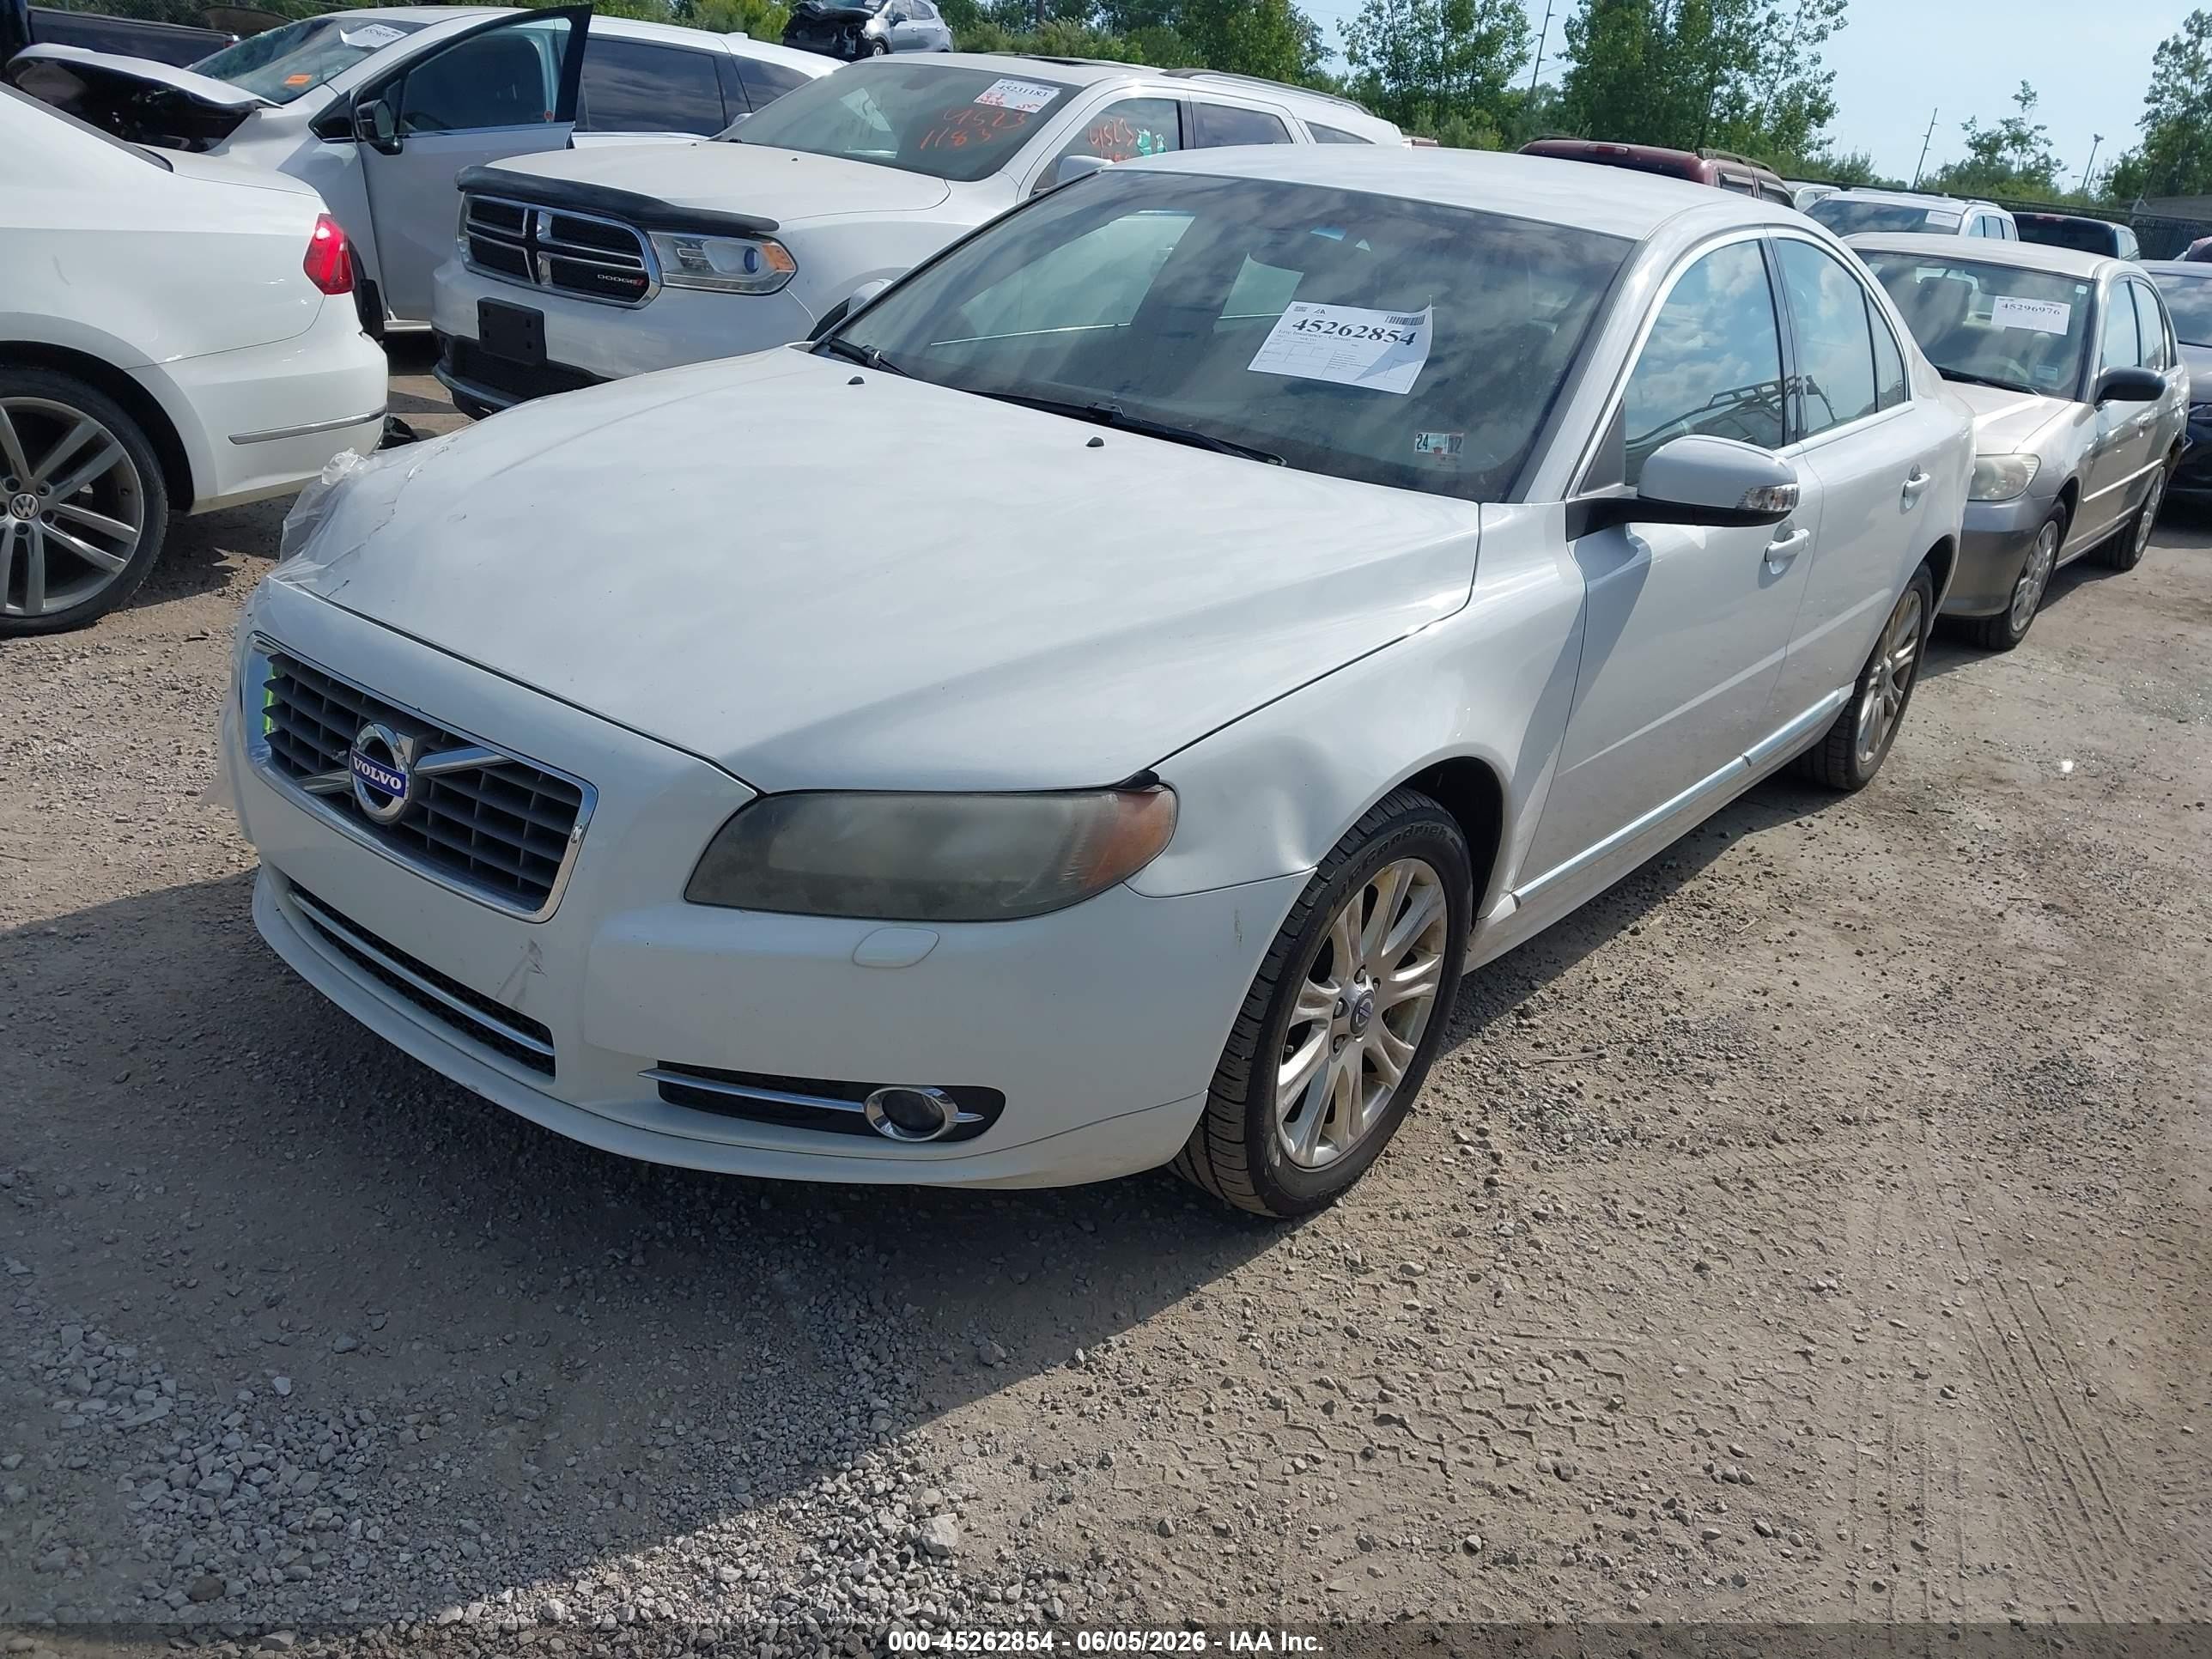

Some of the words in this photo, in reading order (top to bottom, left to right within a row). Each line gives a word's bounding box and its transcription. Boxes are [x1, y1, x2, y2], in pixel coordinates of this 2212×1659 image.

[597, 274, 638, 284] DODGE
[1291, 318, 1416, 344] 45262854
[1416, 433, 1429, 450] 24
[353, 757, 402, 790] VOLVO
